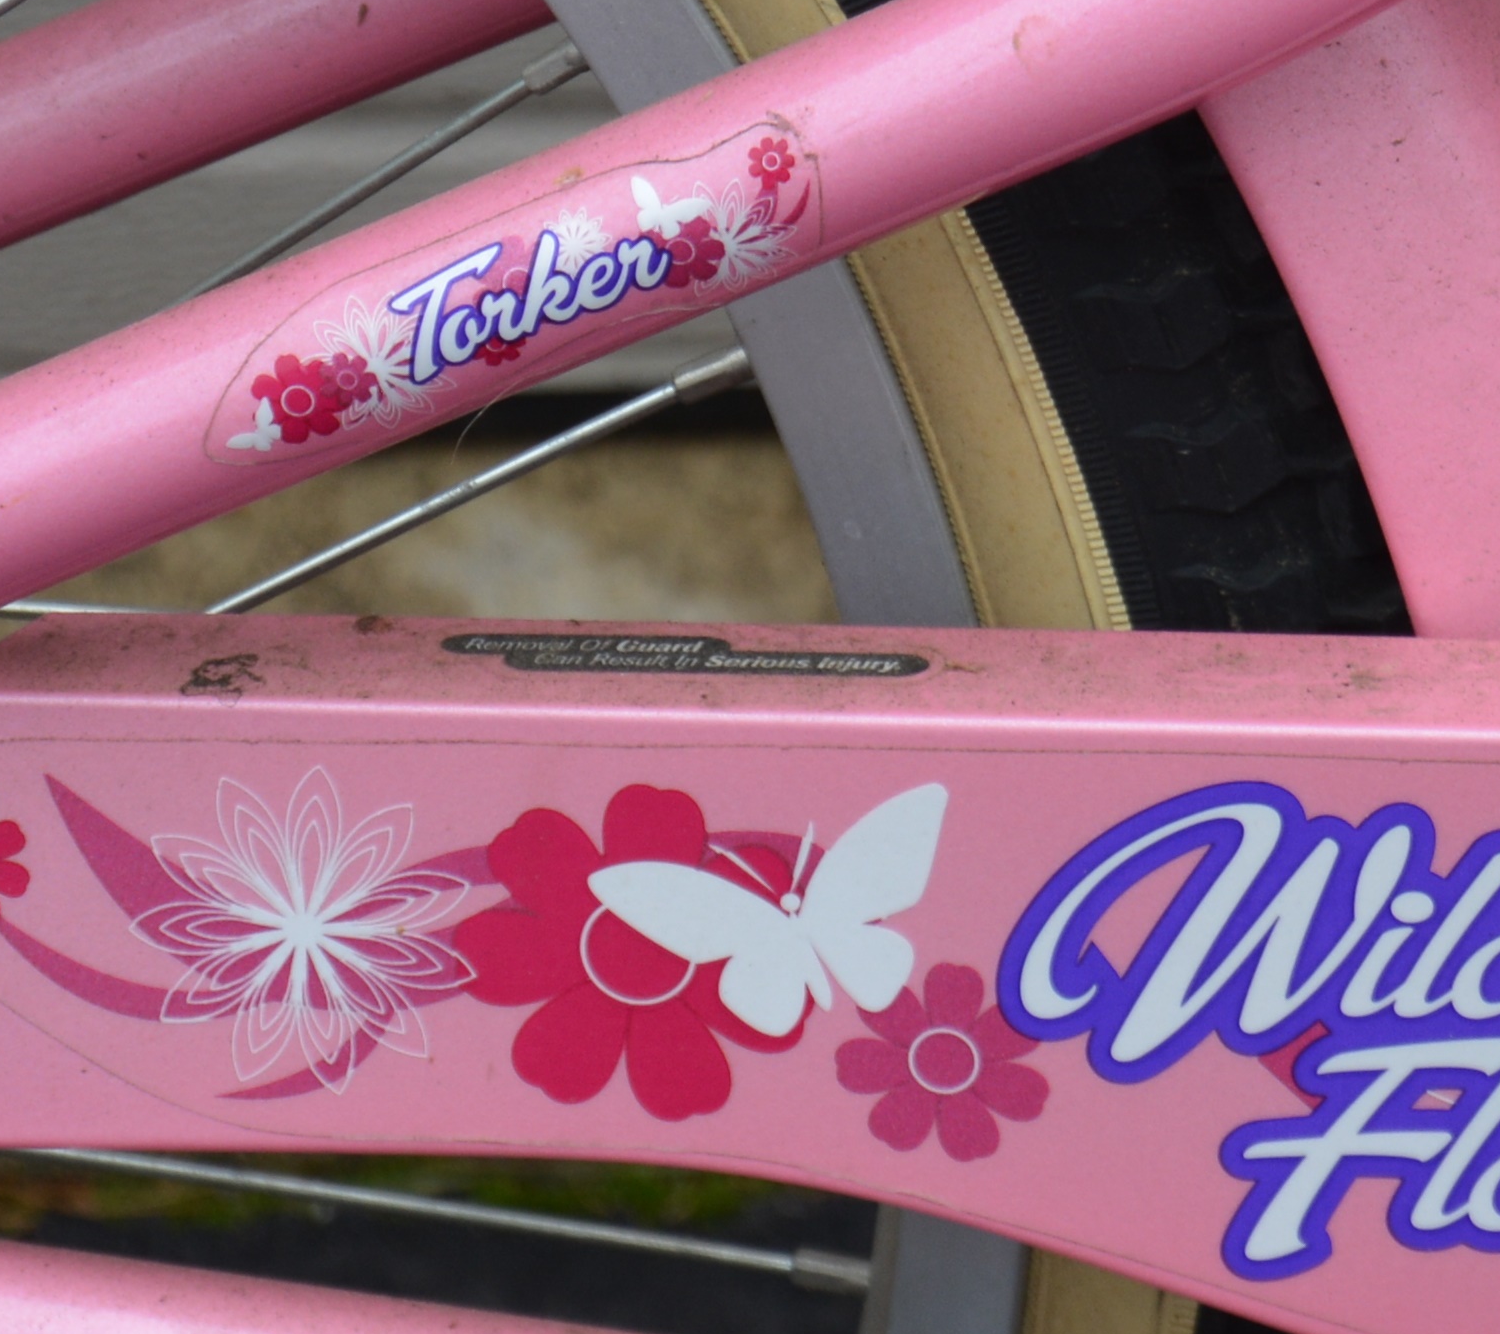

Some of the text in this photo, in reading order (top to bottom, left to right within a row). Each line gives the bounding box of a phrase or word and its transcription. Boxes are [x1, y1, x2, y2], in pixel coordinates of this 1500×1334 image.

[387, 229, 672, 386] Torker
[464, 637, 576, 652] Removal
[615, 639, 706, 654] Guard
[533, 652, 582, 666] Can
[589, 653, 669, 668] Result
[703, 654, 811, 669] Serious
